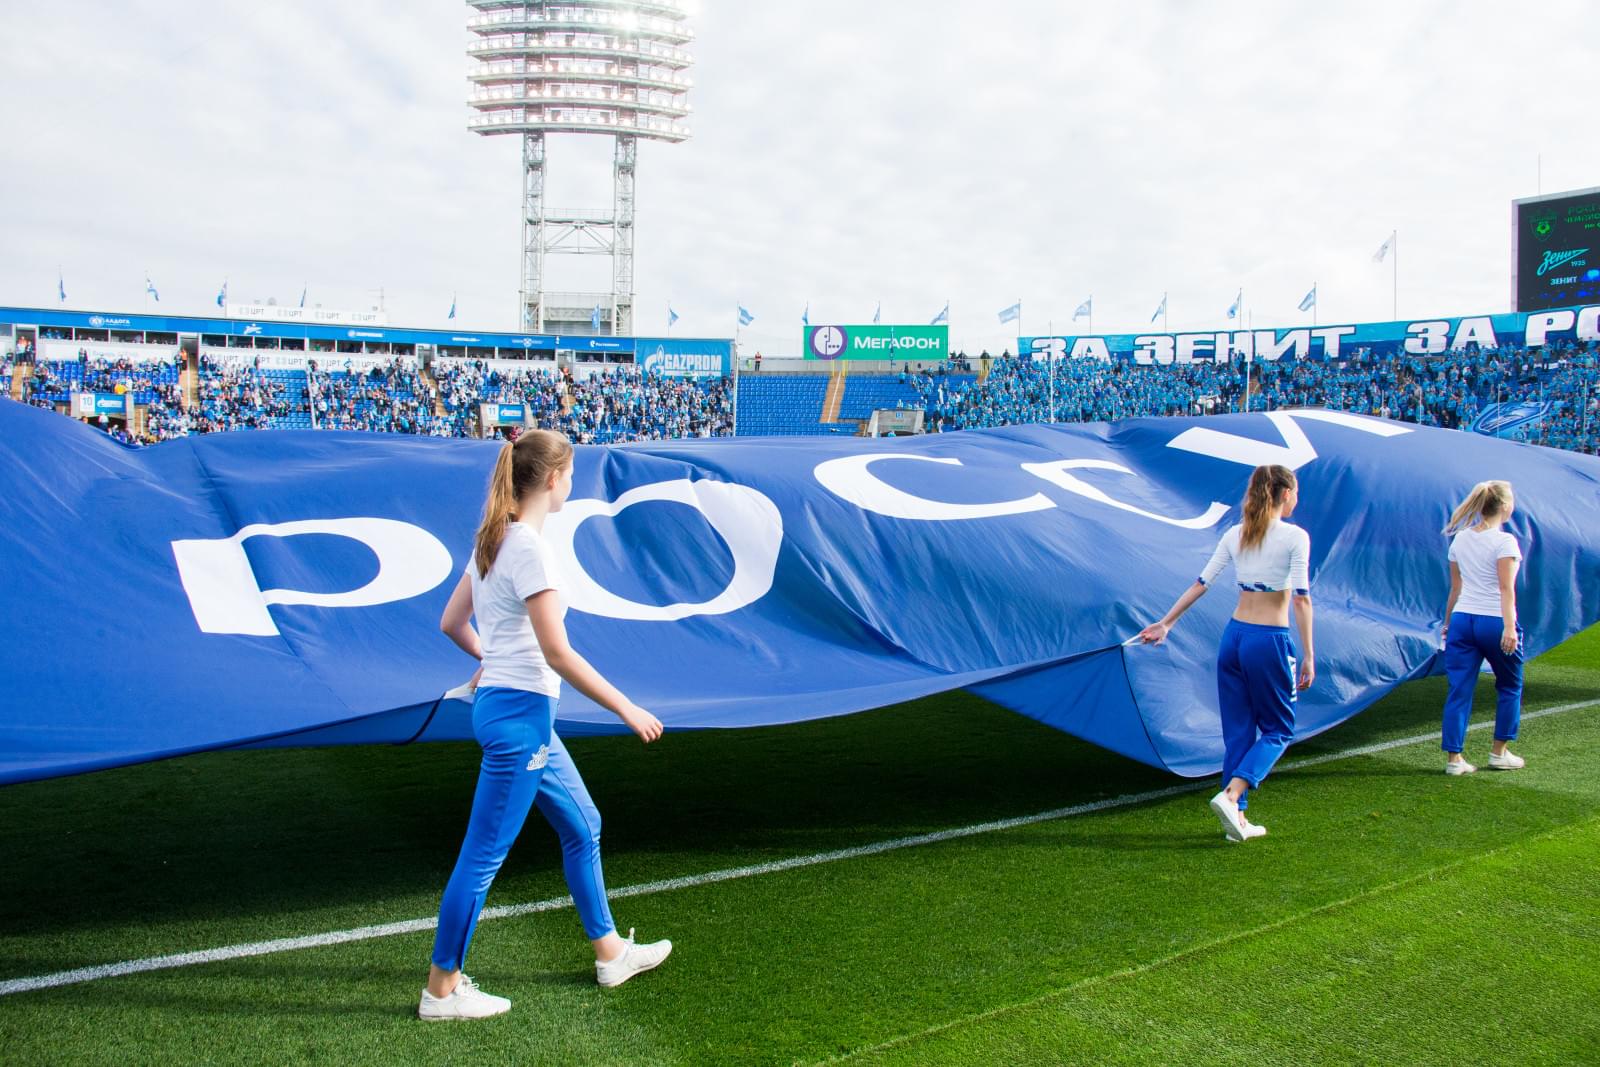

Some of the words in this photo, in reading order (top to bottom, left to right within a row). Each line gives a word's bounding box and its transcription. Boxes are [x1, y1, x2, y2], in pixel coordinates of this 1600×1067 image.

[1550, 276, 1577, 285] ЗЕНИТ
[1031, 337, 1113, 366] ЗА
[1133, 325, 1356, 366] ЗЕНИТ
[1404, 316, 1499, 354] ЗА
[664, 353, 722, 371] GAZPROM
[83, 397, 93, 406] 10
[488, 407, 496, 416] 11
